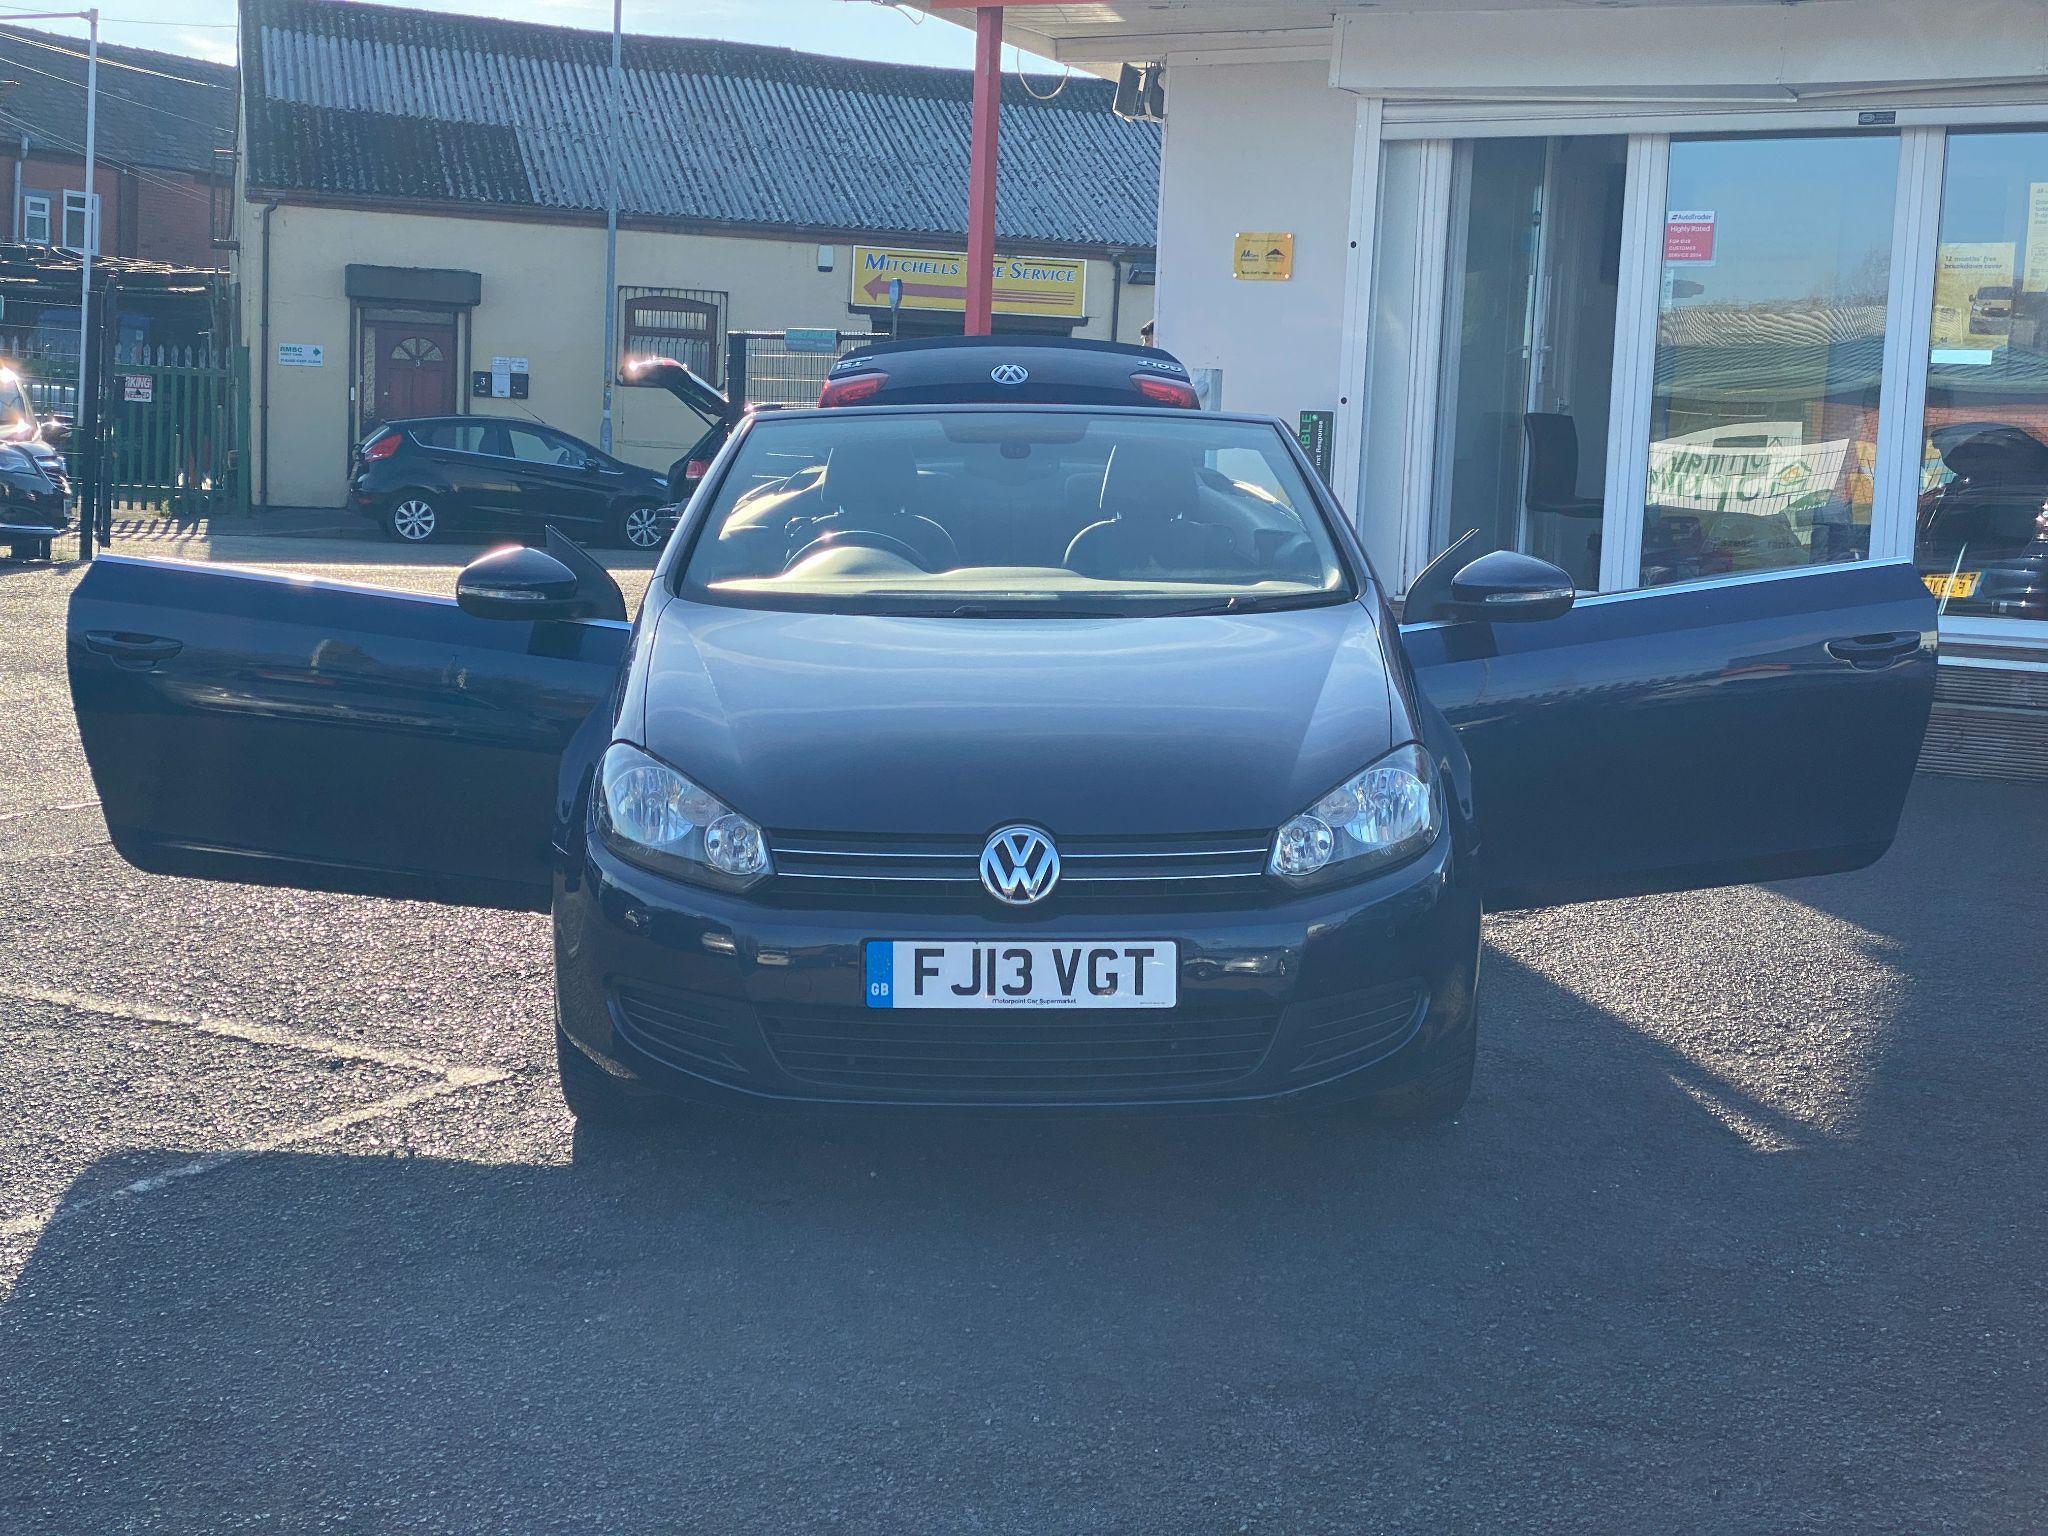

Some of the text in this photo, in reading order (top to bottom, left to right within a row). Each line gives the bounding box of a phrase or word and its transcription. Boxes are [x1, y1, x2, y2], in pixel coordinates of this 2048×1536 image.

[865, 253, 959, 275] MITCHELLS
[1009, 261, 1076, 282] SERVICE
[480, 377, 486, 385] 3
[1315, 420, 1324, 453] Response
[914, 948, 1155, 996] FJ13 VGT
[870, 982, 889, 996] GB
[1040, 998, 1077, 1006] Supermarket
